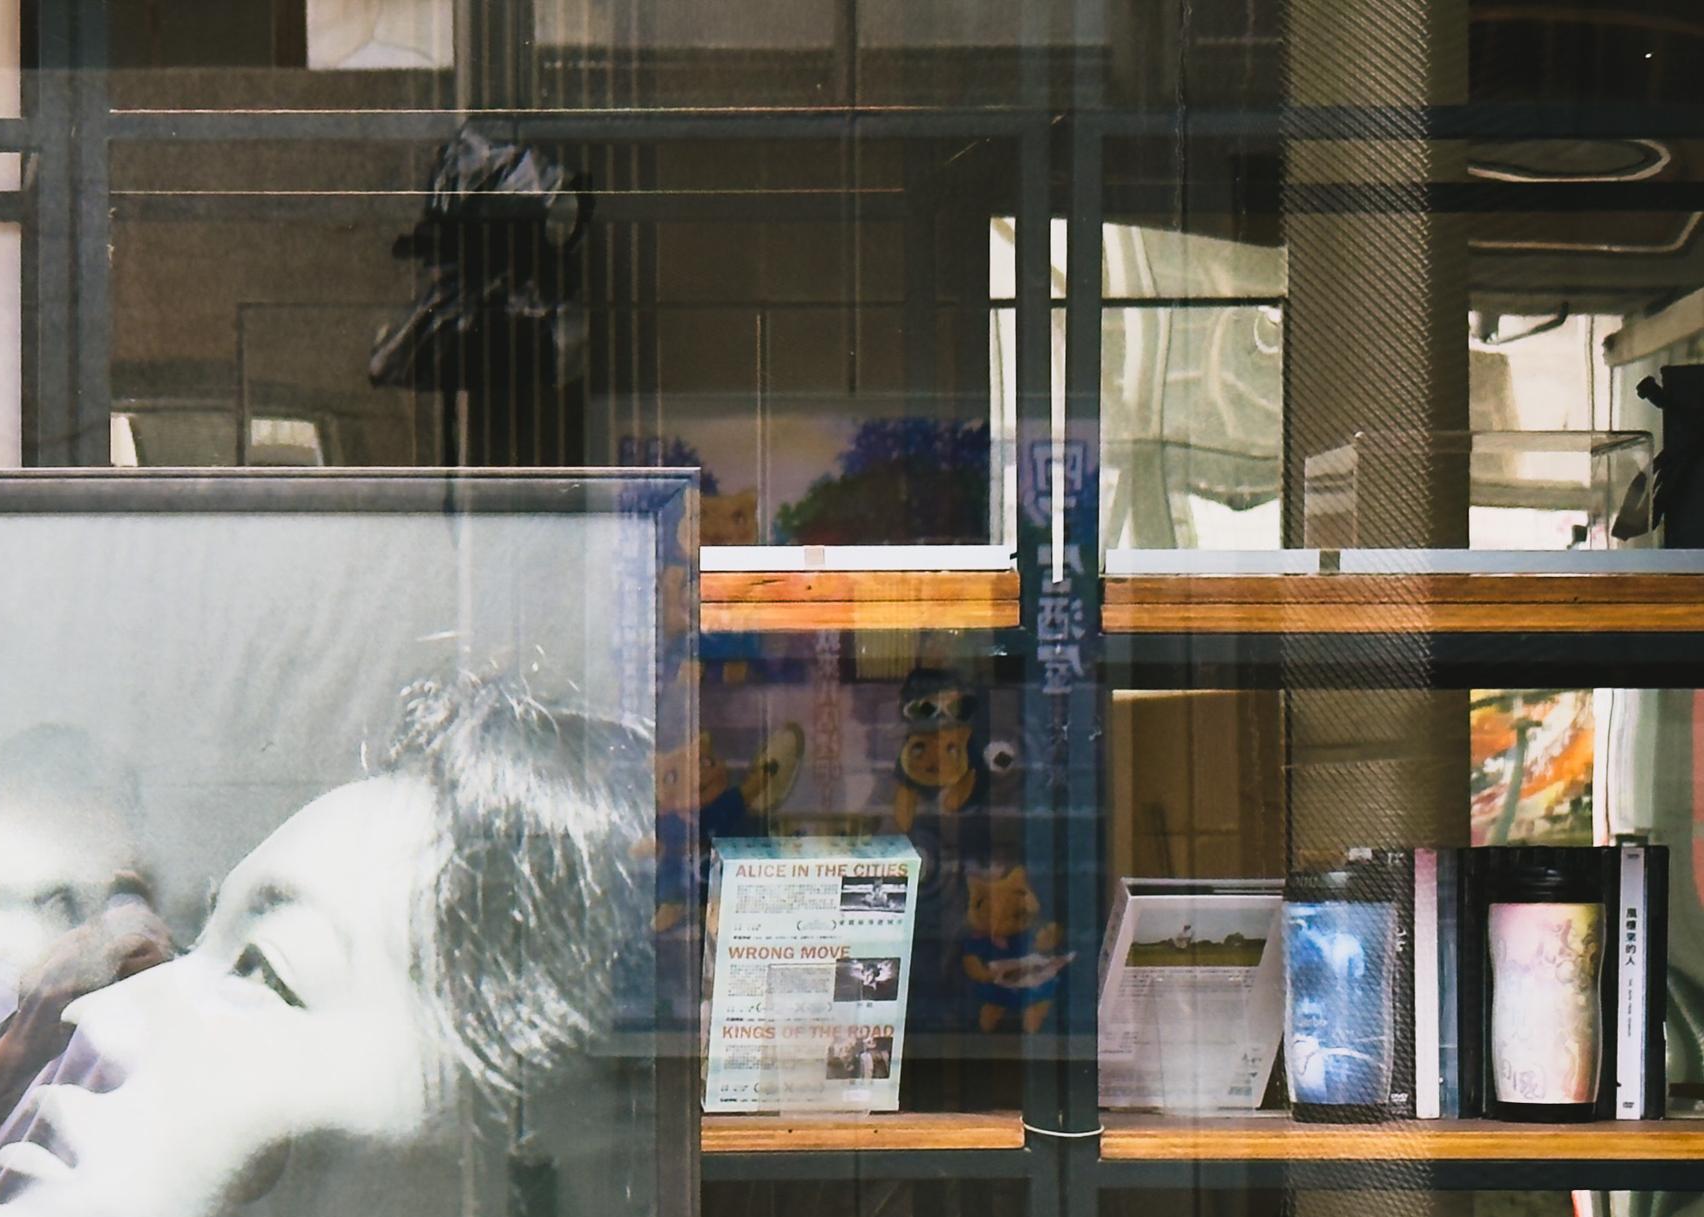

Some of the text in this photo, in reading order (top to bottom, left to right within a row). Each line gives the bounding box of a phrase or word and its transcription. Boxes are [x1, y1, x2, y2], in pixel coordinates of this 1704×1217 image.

[735, 863, 909, 878] ALICE IN THE CITIES
[728, 946, 852, 960] WRONG MOVE
[722, 1024, 895, 1039] KINGS OF THE ROAD
